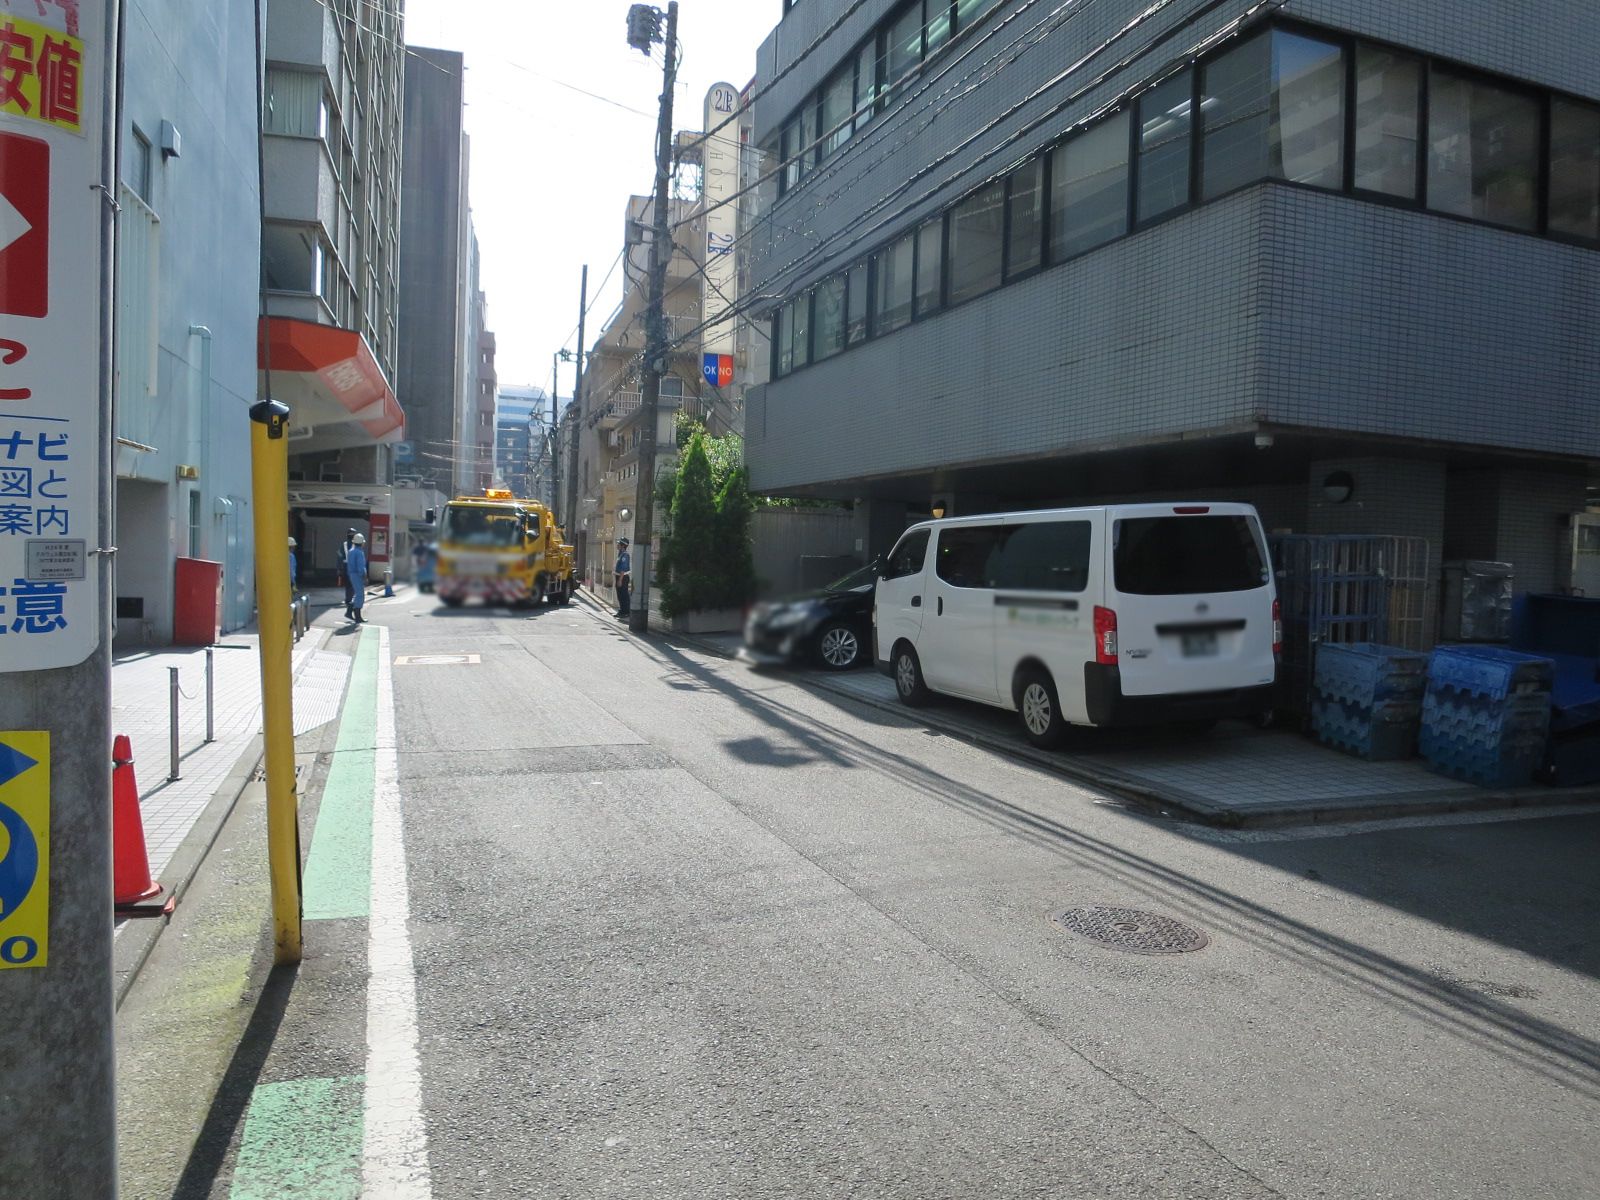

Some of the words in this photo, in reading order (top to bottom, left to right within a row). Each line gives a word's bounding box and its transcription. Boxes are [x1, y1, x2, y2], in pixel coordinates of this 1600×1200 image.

[704, 365, 717, 376] OK
[719, 367, 733, 377] NO
[0, 468, 68, 499] 図と
[0, 503, 69, 536] 案内
[0, 579, 68, 634] 意
